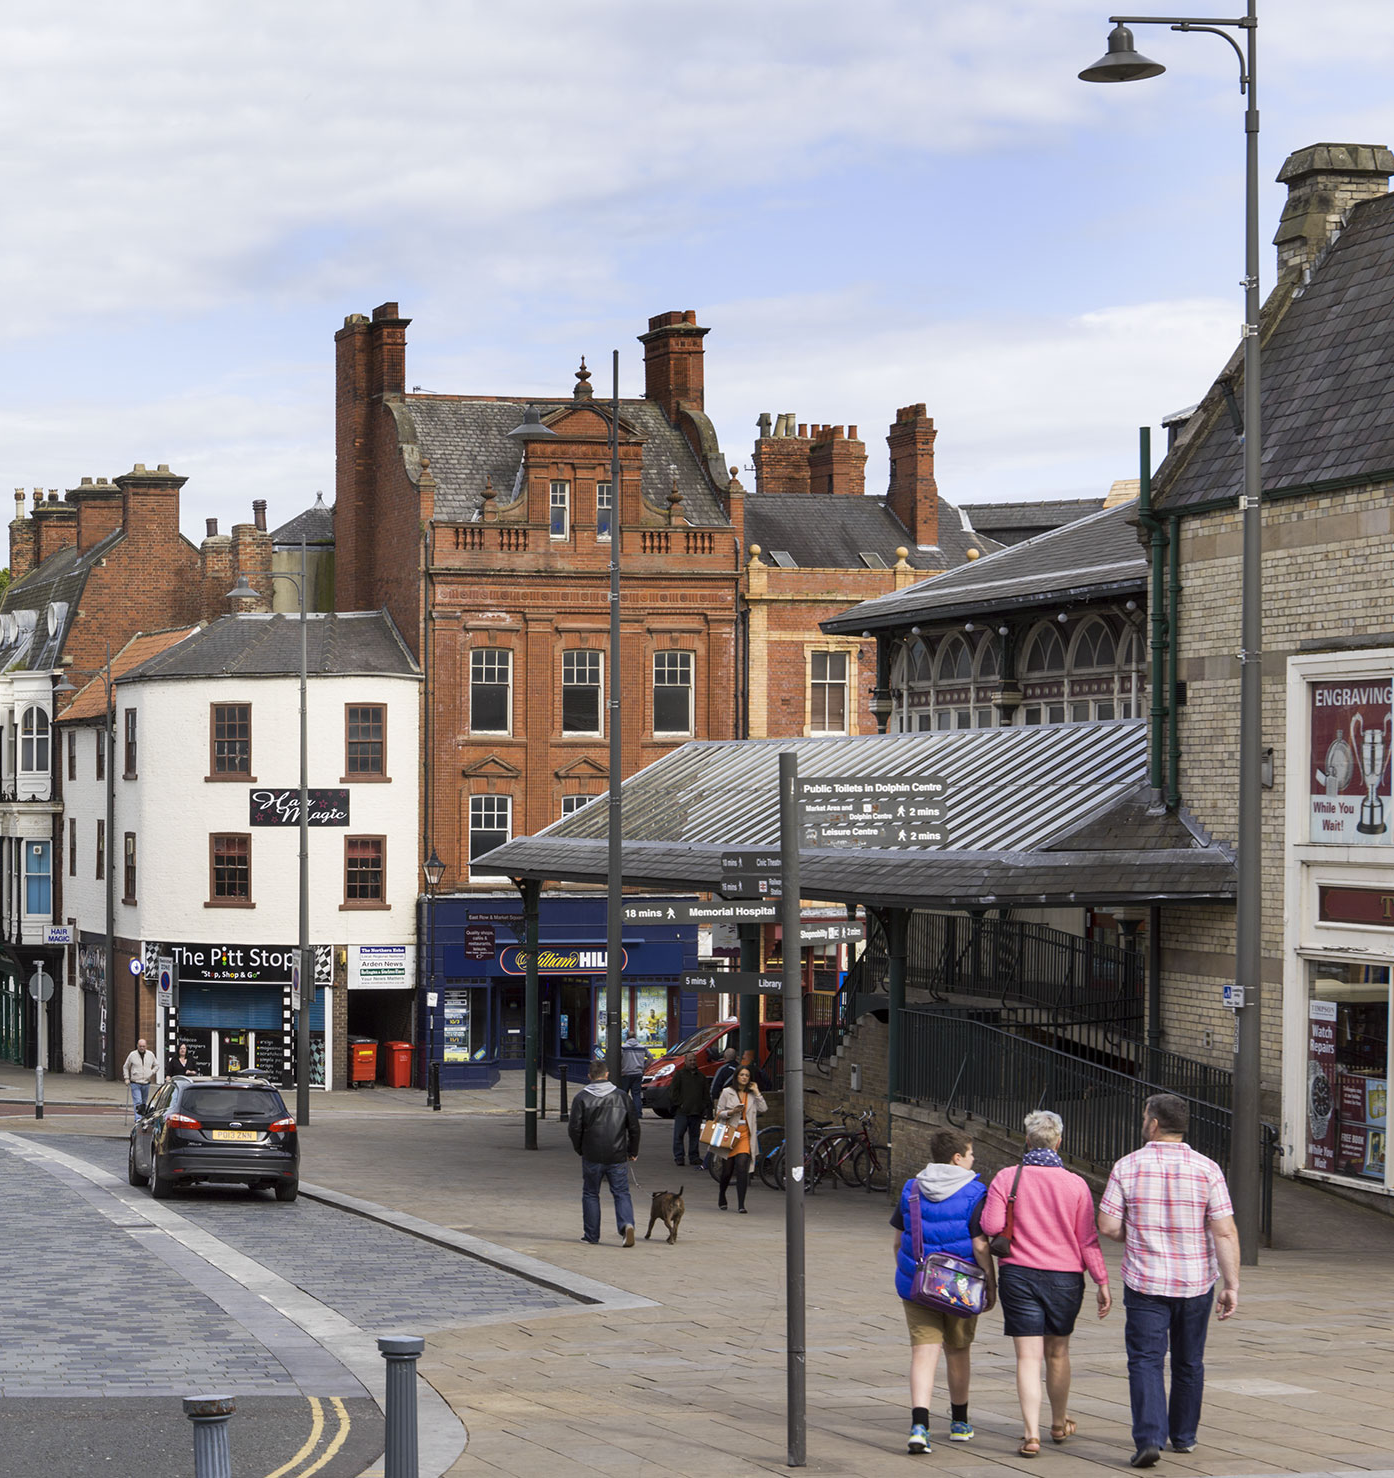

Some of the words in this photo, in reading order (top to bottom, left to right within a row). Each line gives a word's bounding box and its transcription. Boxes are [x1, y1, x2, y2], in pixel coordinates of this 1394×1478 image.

[1315, 686, 1393, 706] ENGRAVING
[804, 784, 832, 794] Public
[834, 784, 863, 792] Toilets
[864, 784, 874, 792] in
[876, 783, 910, 794] Dolphin
[912, 782, 942, 792] Centre
[909, 808, 916, 816] 2
[917, 808, 940, 816] mins
[1314, 802, 1336, 814] While
[1338, 802, 1354, 814] You
[276, 806, 348, 824] Magic
[1322, 819, 1344, 832] Wait!
[918, 832, 941, 840] mins
[728, 858, 737, 866] mins
[756, 858, 767, 866] Civic
[727, 882, 737, 890] mins
[625, 910, 637, 918] 18
[638, 908, 662, 918] mins
[689, 908, 734, 917] Memorial
[736, 906, 776, 917] Hospital
[851, 927, 861, 936] mins
[172, 946, 204, 966] The
[211, 946, 244, 966] Pitt
[250, 948, 293, 971] Stop
[222, 971, 238, 980] Shop
[686, 976, 690, 984] 5
[691, 976, 707, 985] mins
[758, 979, 782, 990] Library
[1312, 1004, 1334, 1013] TIMPSON
[1312, 1024, 1332, 1038] Watch
[1310, 1038, 1334, 1055] Repairs
[1342, 1132, 1352, 1143] FREE
[1308, 1143, 1322, 1155] While
[1324, 1146, 1334, 1158] You
[1314, 1157, 1327, 1170] Wait
